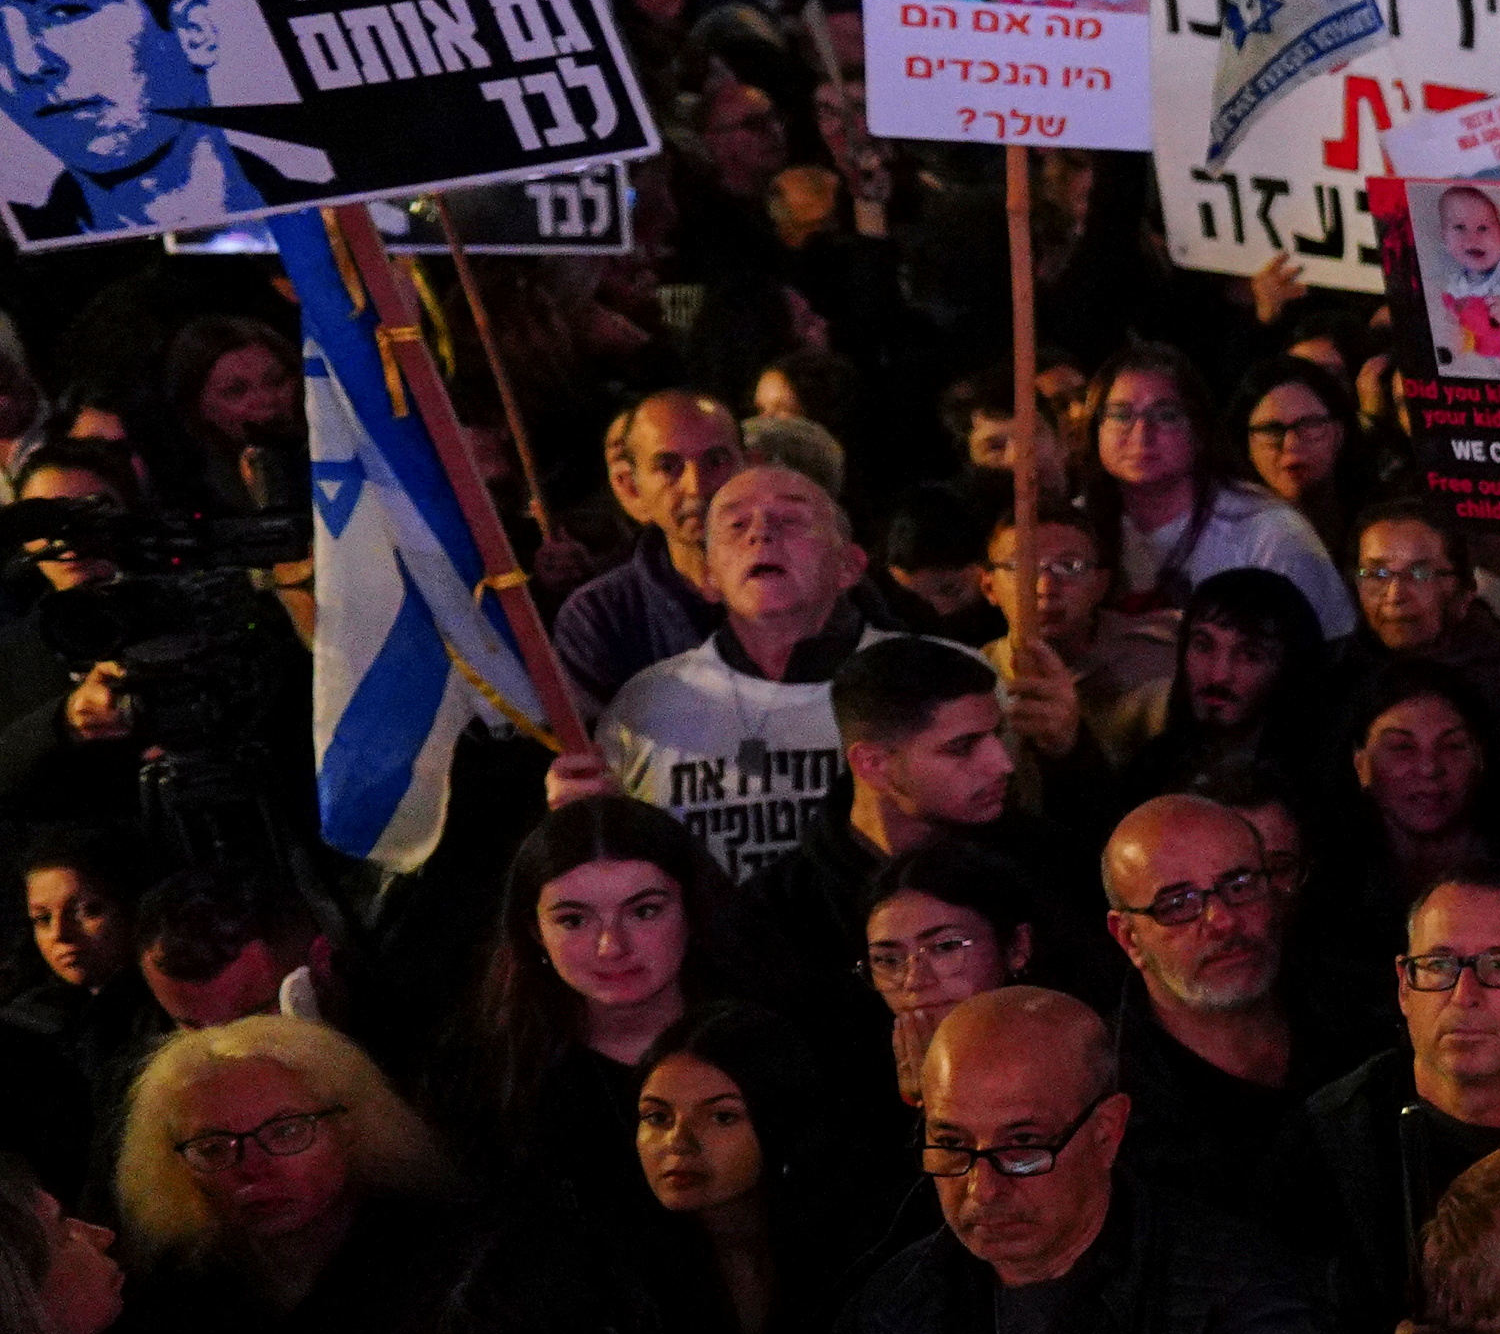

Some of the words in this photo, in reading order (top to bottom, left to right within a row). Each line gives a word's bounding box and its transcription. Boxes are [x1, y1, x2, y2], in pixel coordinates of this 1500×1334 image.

[901, 4, 957, 29] הם
[973, 10, 1043, 35] אם
[1054, 15, 1102, 39] מה
[906, 56, 1048, 86] הנכדים
[1063, 67, 1111, 90] היו
[481, 57, 617, 150] לבד
[958, 108, 1066, 139] שלך?
[524, 176, 608, 235] לבד
[1443, 387, 1481, 404] you
[1423, 410, 1467, 428] your
[1451, 440, 1486, 461] WE
[1427, 472, 1472, 493] Free
